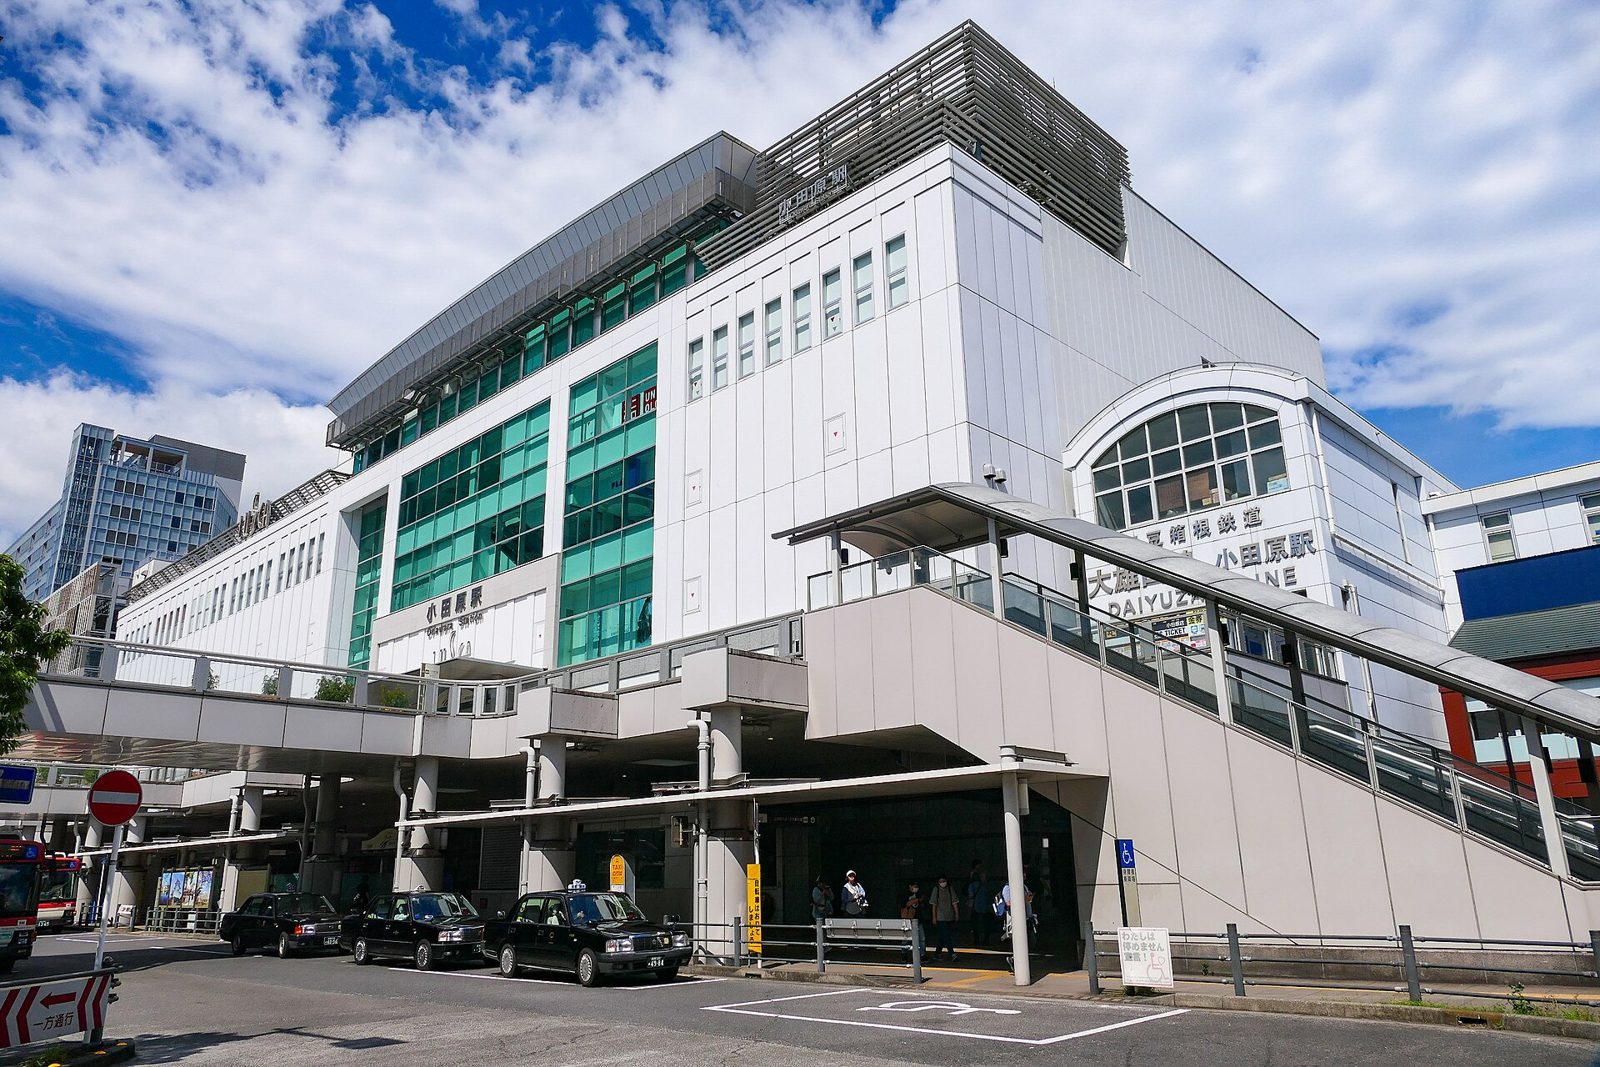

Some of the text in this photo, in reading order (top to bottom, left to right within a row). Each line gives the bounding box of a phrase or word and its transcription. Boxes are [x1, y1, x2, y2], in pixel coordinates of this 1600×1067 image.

[1135, 506, 1262, 547] 豆箱根鉄道
[1215, 529, 1316, 570] 小田原駅
[427, 585, 482, 624] 小田原駅
[1165, 628, 1185, 637] TICKET
[1122, 931, 1155, 941] わたしは
[1123, 941, 1165, 952] 停めません
[33, 1011, 74, 1030] 一方通行
